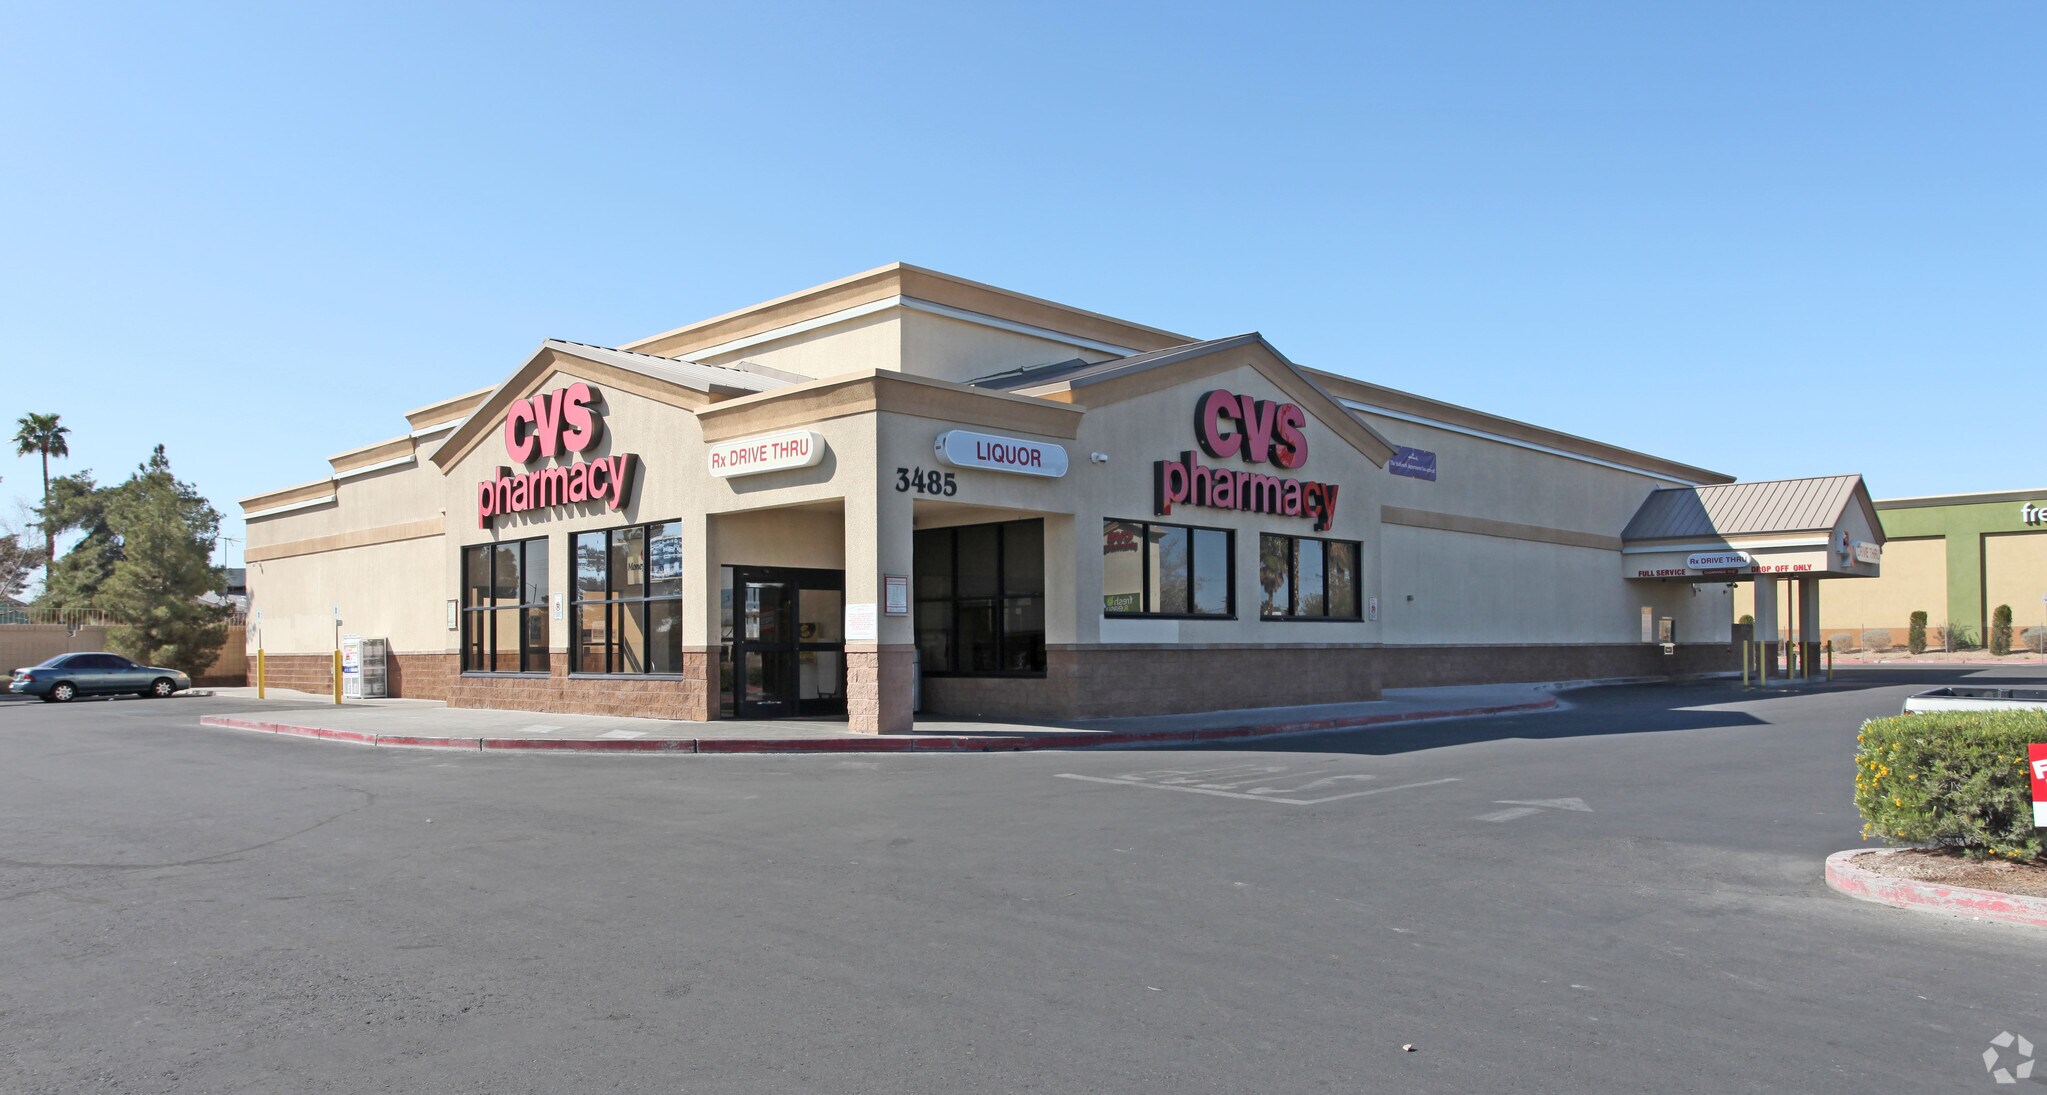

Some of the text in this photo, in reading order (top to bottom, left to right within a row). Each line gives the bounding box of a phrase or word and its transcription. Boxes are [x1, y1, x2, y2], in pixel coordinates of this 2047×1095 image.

[505, 382, 600, 464] CVS
[1197, 389, 1309, 469] CVS
[711, 438, 809, 469] Rx DRIVE THRU
[976, 440, 1042, 468] LIQUOR
[478, 453, 635, 529] pharmacy
[895, 466, 958, 497] 3485
[1158, 450, 1339, 531] pharmacy
[1656, 568, 1686, 577] SERVICE
[1701, 556, 1724, 565] DRIVE
[1751, 565, 1772, 573] DROP
[1775, 564, 1790, 573] OFF
